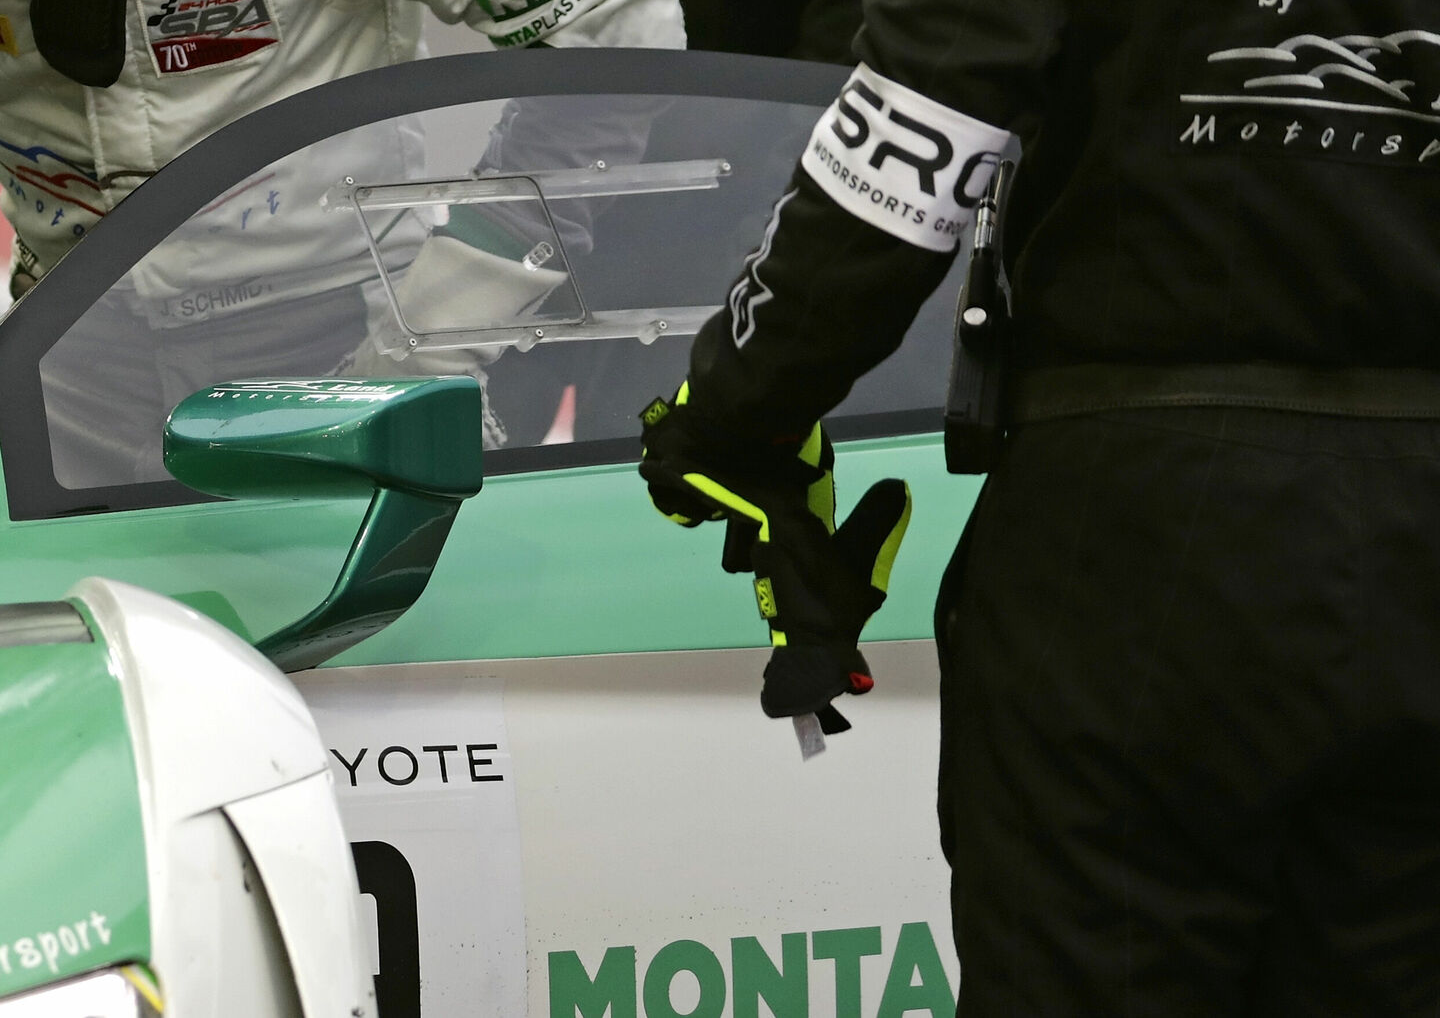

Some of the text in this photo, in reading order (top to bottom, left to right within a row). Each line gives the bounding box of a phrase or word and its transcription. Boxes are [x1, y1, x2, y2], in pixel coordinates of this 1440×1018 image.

[814, 139, 926, 226] MOTORSPORTS
[327, 384, 395, 393] Land
[330, 743, 504, 787] YOTE
[548, 921, 960, 1018] MONTA
